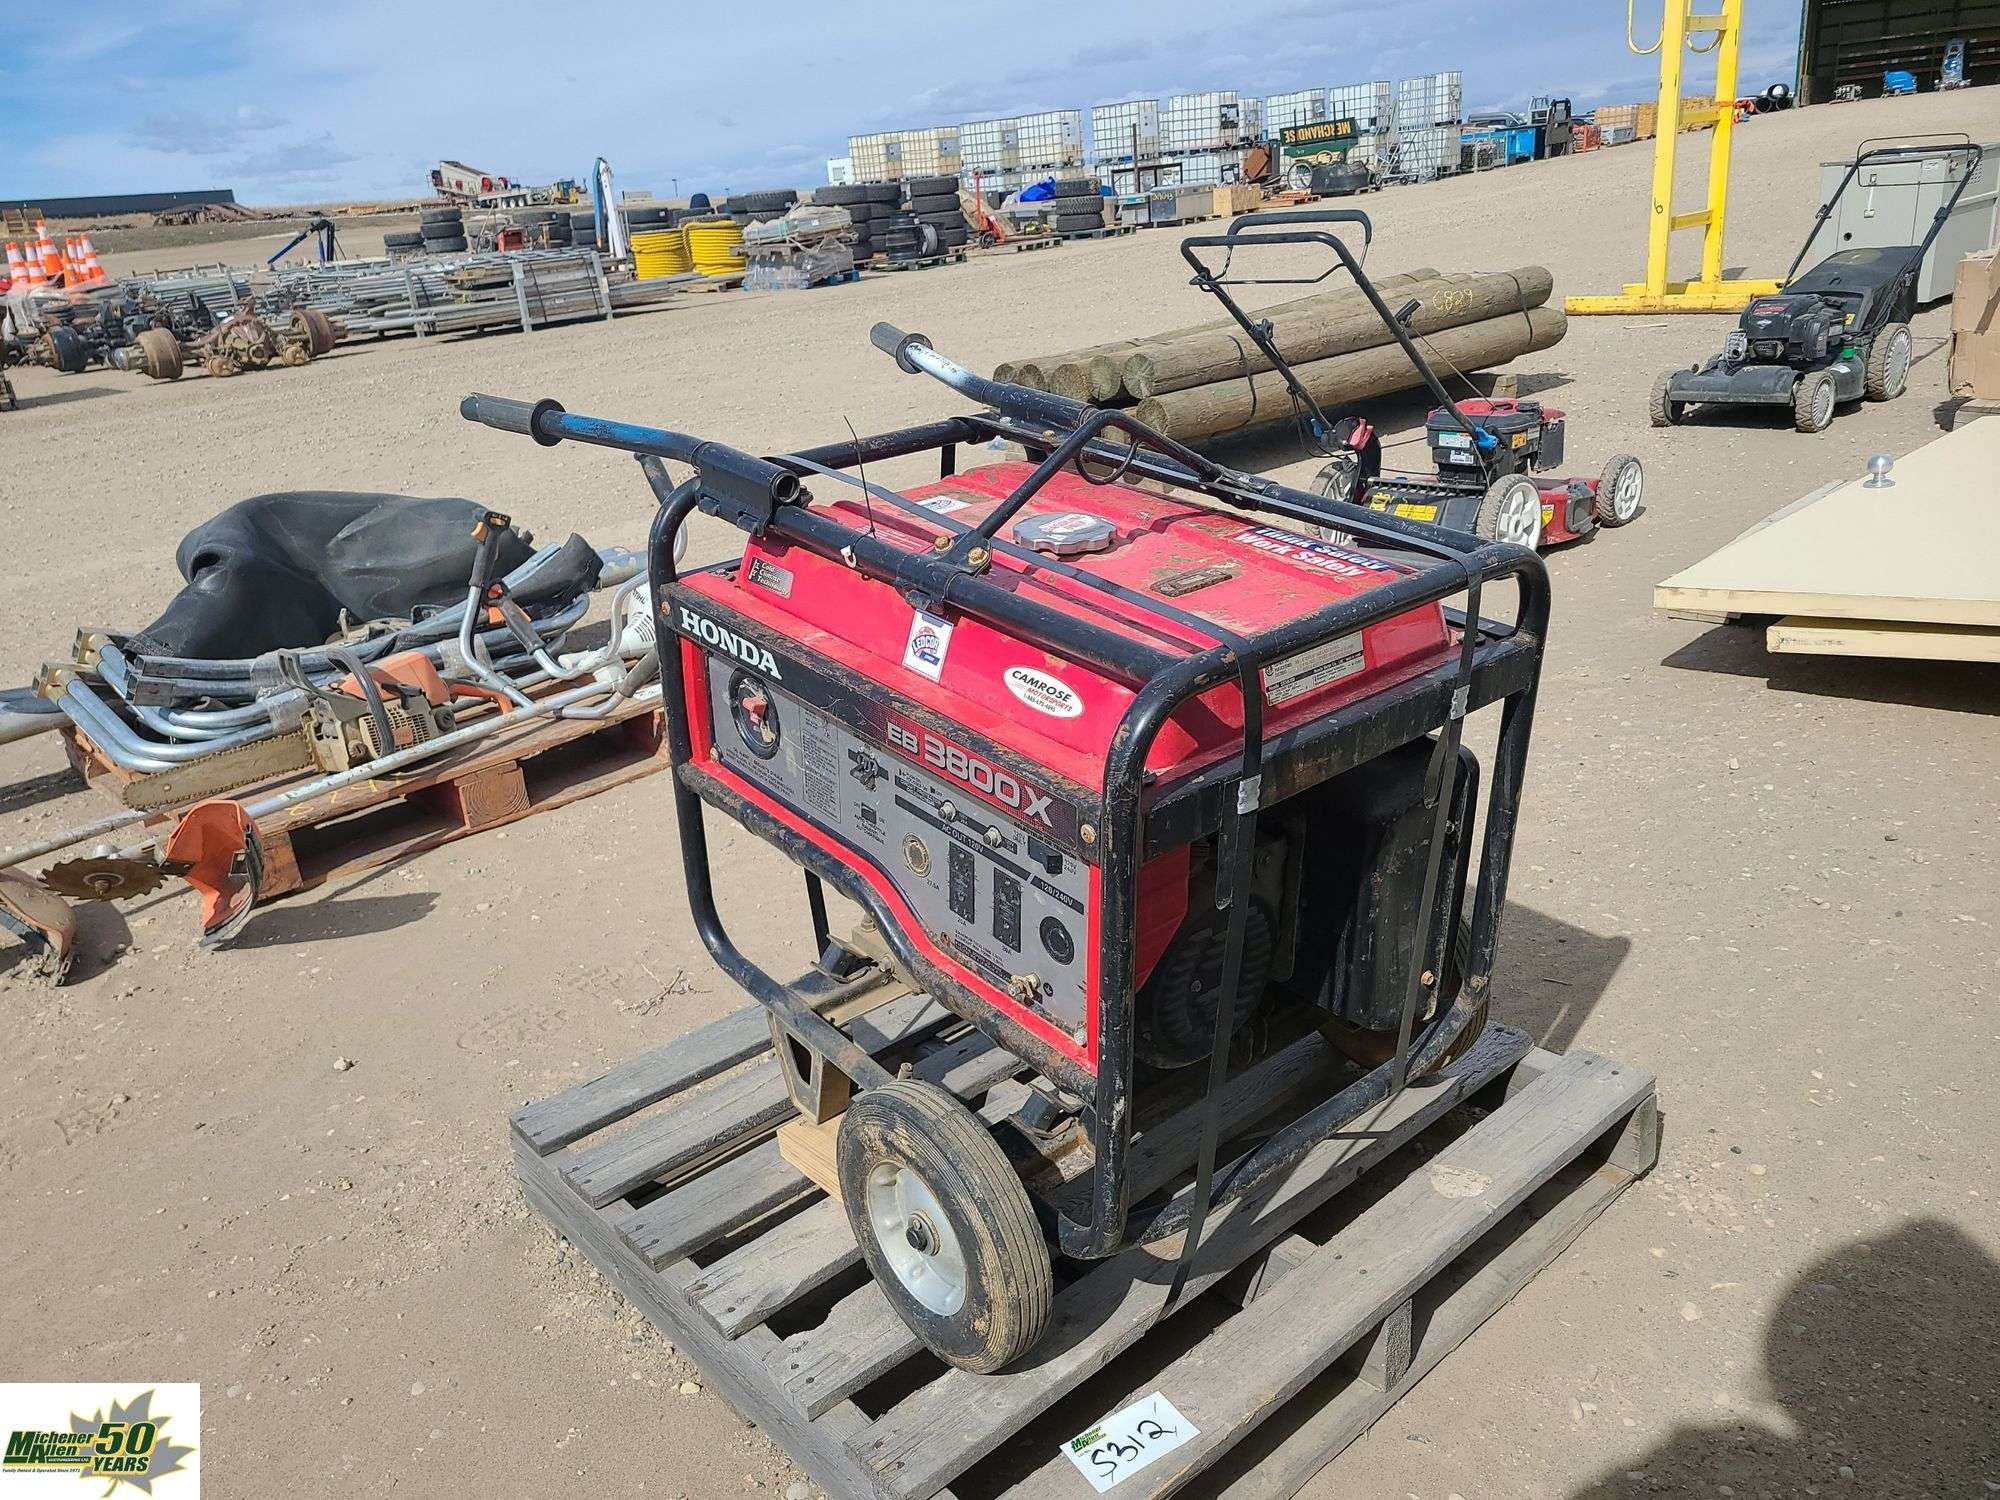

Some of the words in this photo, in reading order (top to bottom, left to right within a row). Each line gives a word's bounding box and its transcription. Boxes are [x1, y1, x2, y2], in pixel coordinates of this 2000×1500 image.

[1233, 532, 1295, 555] Work
[1256, 527, 1317, 549] Think
[1315, 544, 1391, 570] Safety
[679, 607, 783, 680] HONDA
[912, 634, 940, 654] LEDCOR
[1012, 670, 1073, 703] CAMROSE
[1027, 687, 1073, 712] MOTORSPORTS
[887, 721, 920, 754] EB
[924, 736, 1054, 828] 3800X
[941, 824, 953, 835] AC
[952, 830, 966, 844] OUT
[968, 838, 984, 854] 120V
[1040, 881, 1074, 906] 120/240V
[1091, 1419, 1177, 1478] S312
